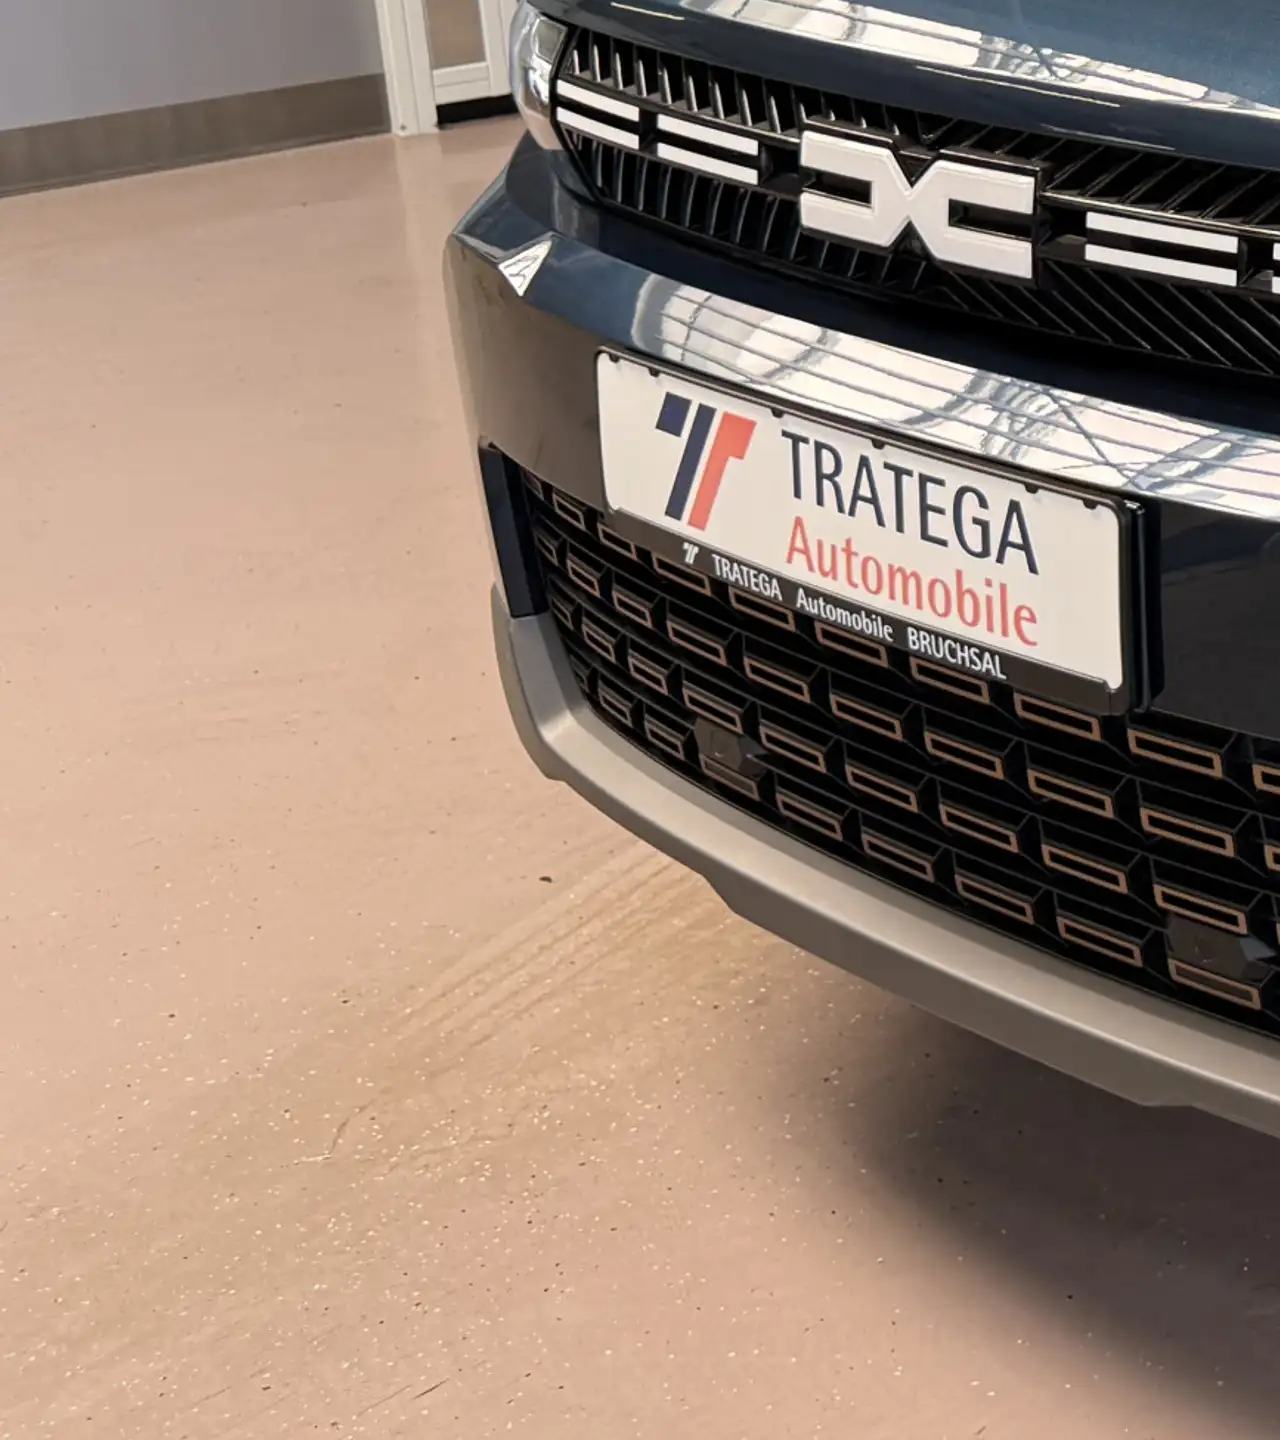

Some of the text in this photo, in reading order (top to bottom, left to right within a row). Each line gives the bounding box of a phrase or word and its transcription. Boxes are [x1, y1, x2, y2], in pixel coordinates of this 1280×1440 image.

[781, 428, 1040, 575] TRATEGA
[712, 553, 1007, 680] TRATEGA Automobile BRUCHSAL
[786, 515, 1039, 647] Automobile
